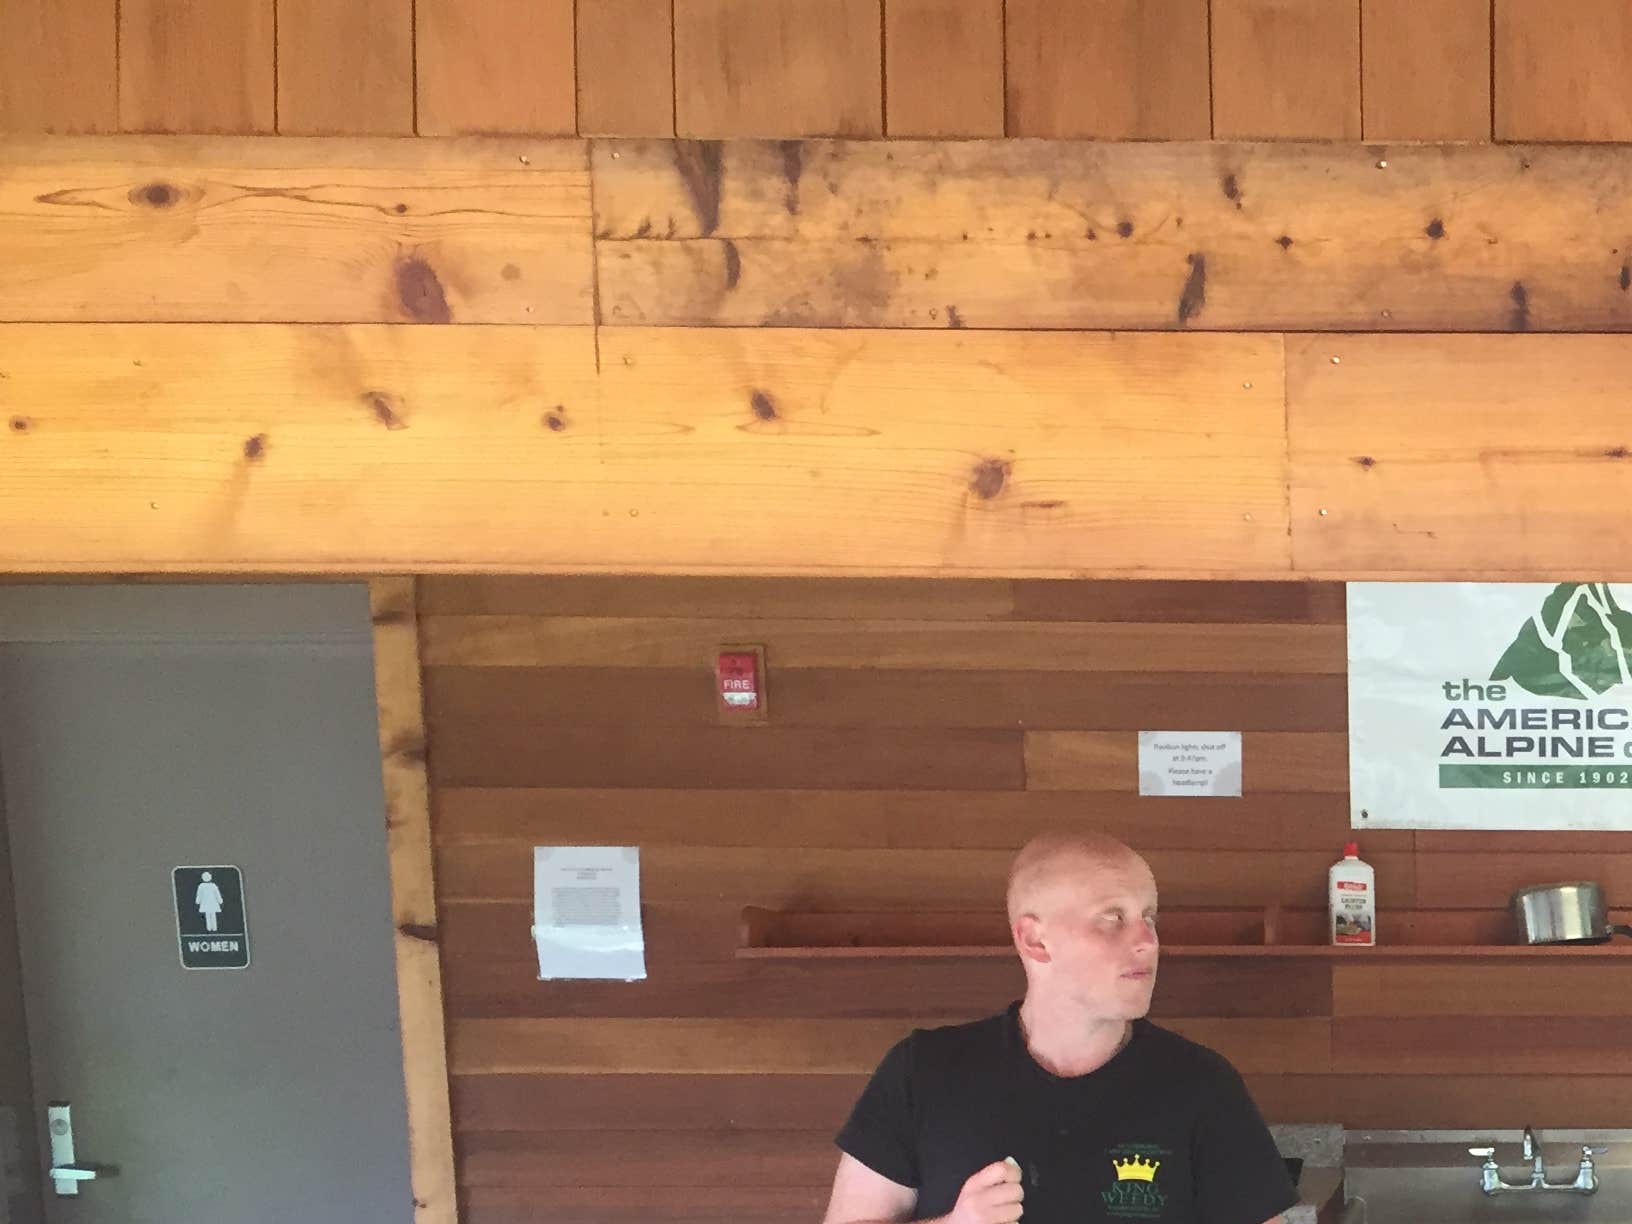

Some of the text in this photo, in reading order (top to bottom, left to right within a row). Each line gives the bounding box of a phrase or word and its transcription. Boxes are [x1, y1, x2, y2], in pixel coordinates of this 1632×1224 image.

[723, 679, 751, 690] FIRE
[1442, 679, 1507, 701] the
[1441, 736, 1615, 758] ALPINE
[1502, 771, 1630, 784] SINCE 1902
[188, 941, 239, 952] WOMEN
